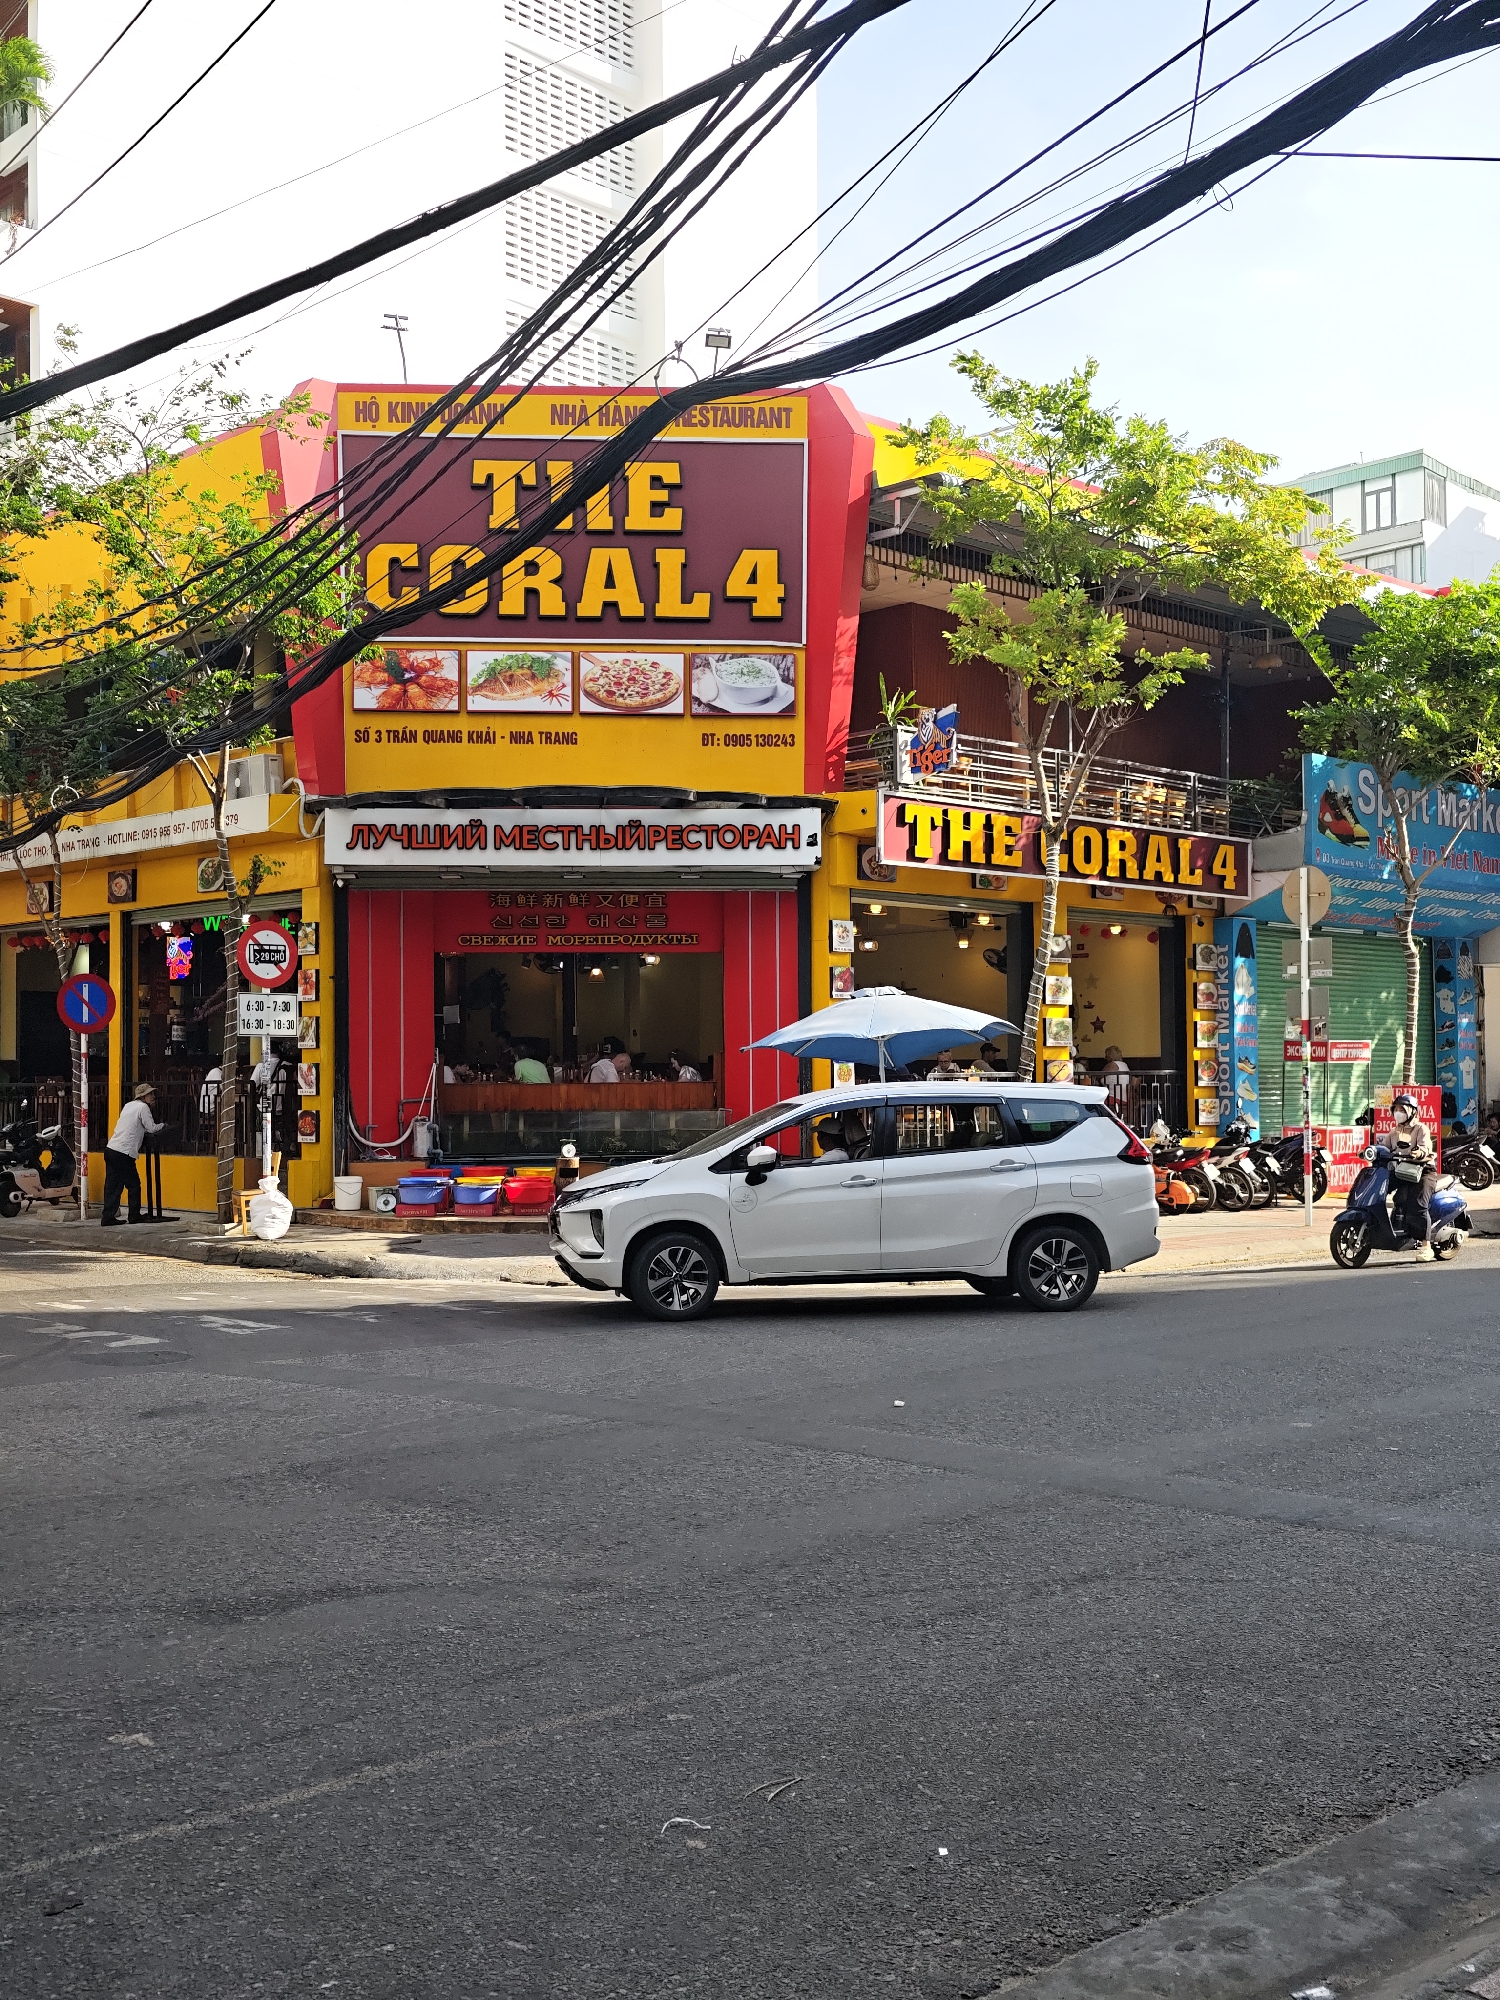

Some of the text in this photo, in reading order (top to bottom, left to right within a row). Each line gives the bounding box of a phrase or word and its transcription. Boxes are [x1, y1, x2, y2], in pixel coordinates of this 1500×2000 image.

[354, 396, 380, 428] HỘ
[550, 399, 590, 426] NHÀ
[366, 542, 786, 621] CORAL 4
[354, 726, 371, 744] SỐ
[374, 729, 383, 744] 3
[385, 725, 418, 744] TRẦN
[422, 729, 463, 745] QUANG
[467, 726, 497, 745] KHẢI
[509, 731, 535, 746] NHA
[538, 731, 578, 746] TRANG
[701, 732, 721, 747] ĐT:
[905, 742, 952, 775] Tiger
[76, 837, 101, 851] TRANG
[107, 832, 141, 845] HOTLINE:
[141, 828, 158, 840] 0915
[173, 822, 186, 835] 957
[346, 819, 488, 851] ЛУЧШИЙ
[903, 802, 1023, 868] THE
[1212, 843, 1238, 890] 4
[1421, 841, 1437, 867] in
[490, 913, 668, 930] 신선한 해산물
[457, 933, 700, 949] СВЕЖИЕ МОРЕПРОДУКТЫ
[1215, 944, 1230, 1034] Market
[246, 1000, 264, 1012] 6:30
[272, 1000, 291, 1013] 7:30
[241, 1018, 264, 1031] 16:30
[273, 1018, 295, 1031] 18:30
